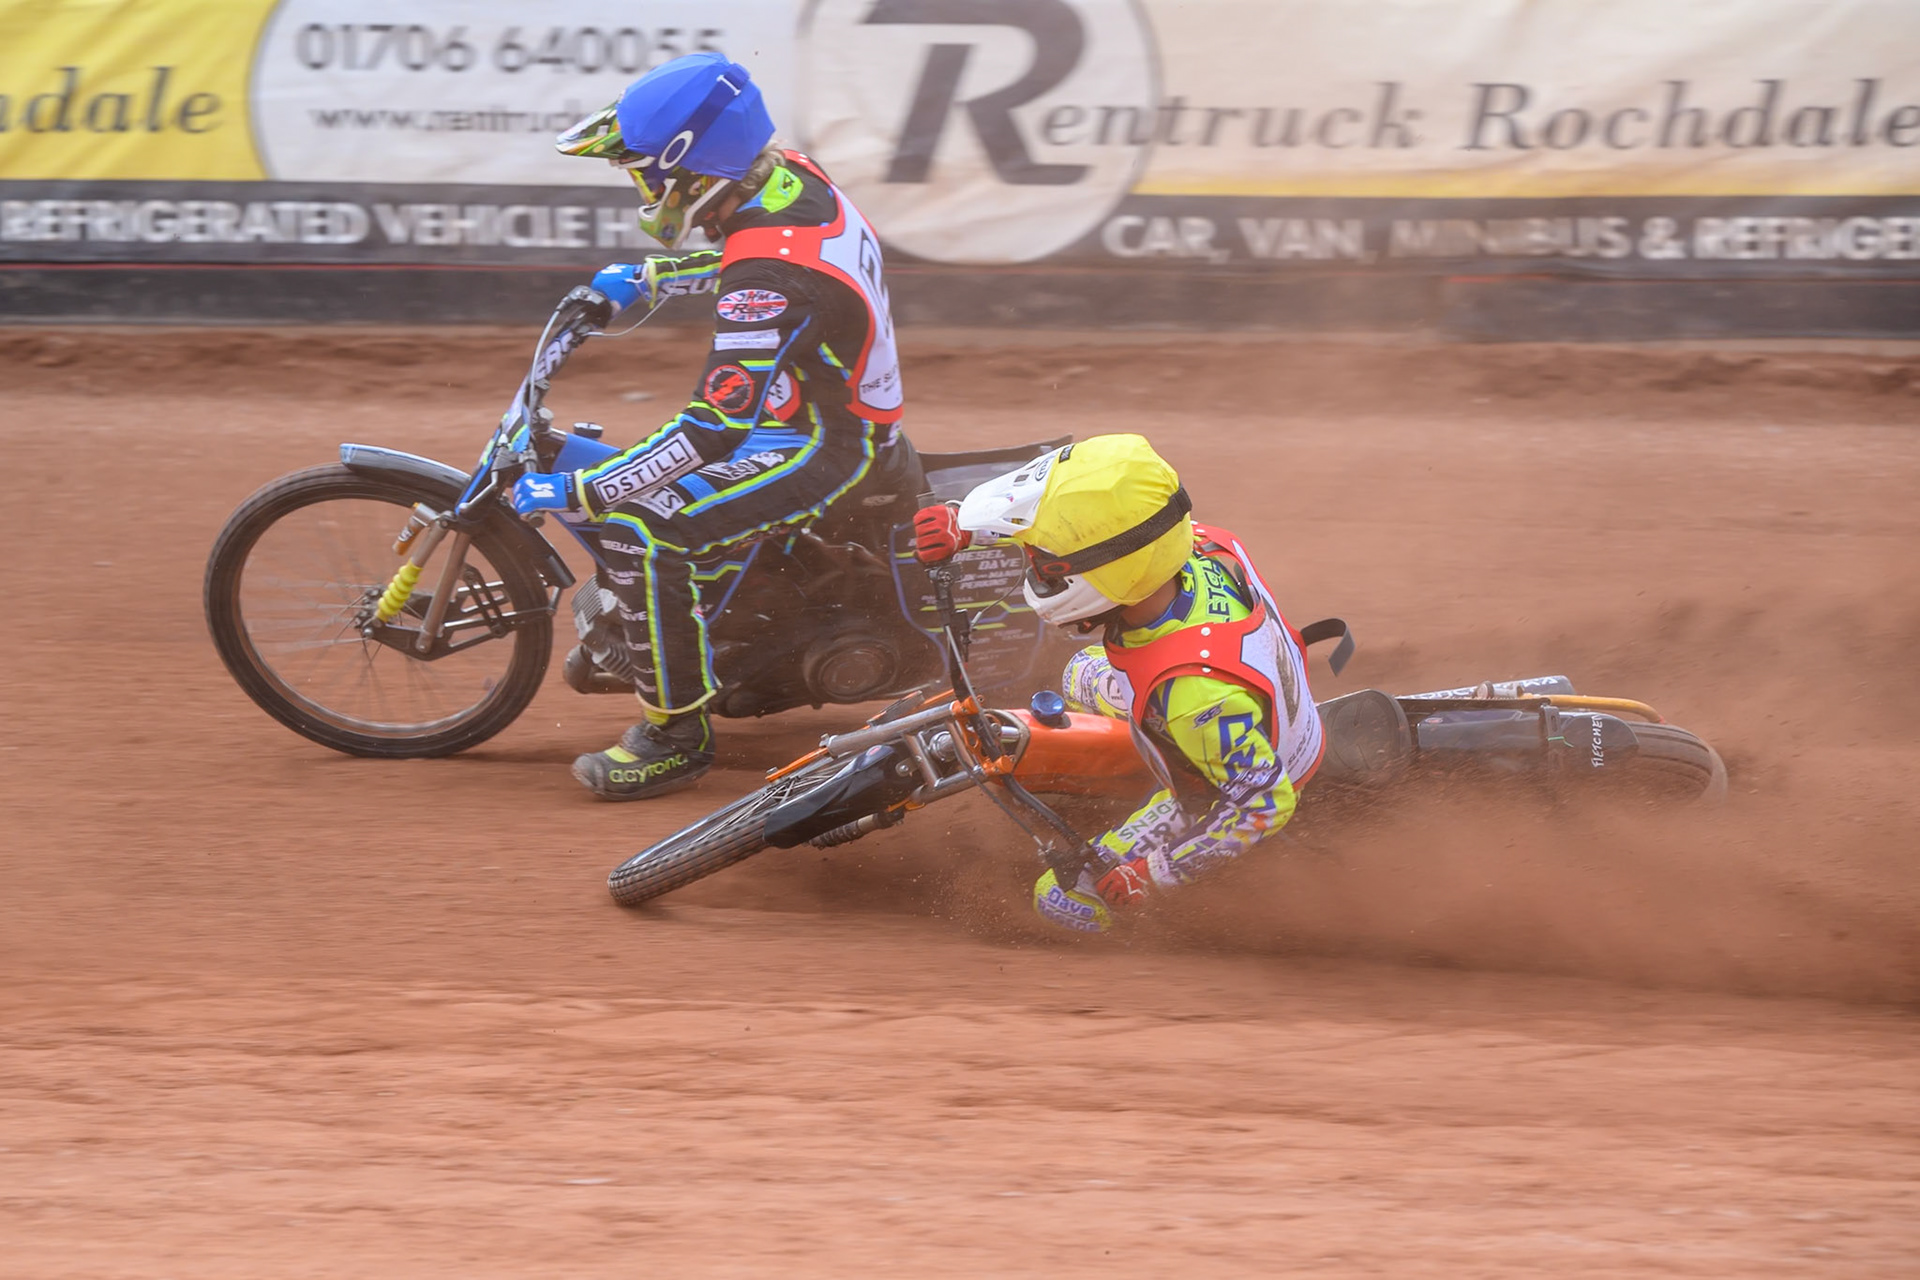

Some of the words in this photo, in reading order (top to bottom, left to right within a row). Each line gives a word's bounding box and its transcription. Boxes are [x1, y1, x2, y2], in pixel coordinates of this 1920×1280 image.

[299, 23, 476, 73] 01706
[0, 66, 223, 134] dale
[1458, 78, 1920, 151] Rochdale
[1638, 216, 1686, 260] &
[1693, 216, 1920, 260] REFRIGE
[602, 450, 686, 501] DSTILL
